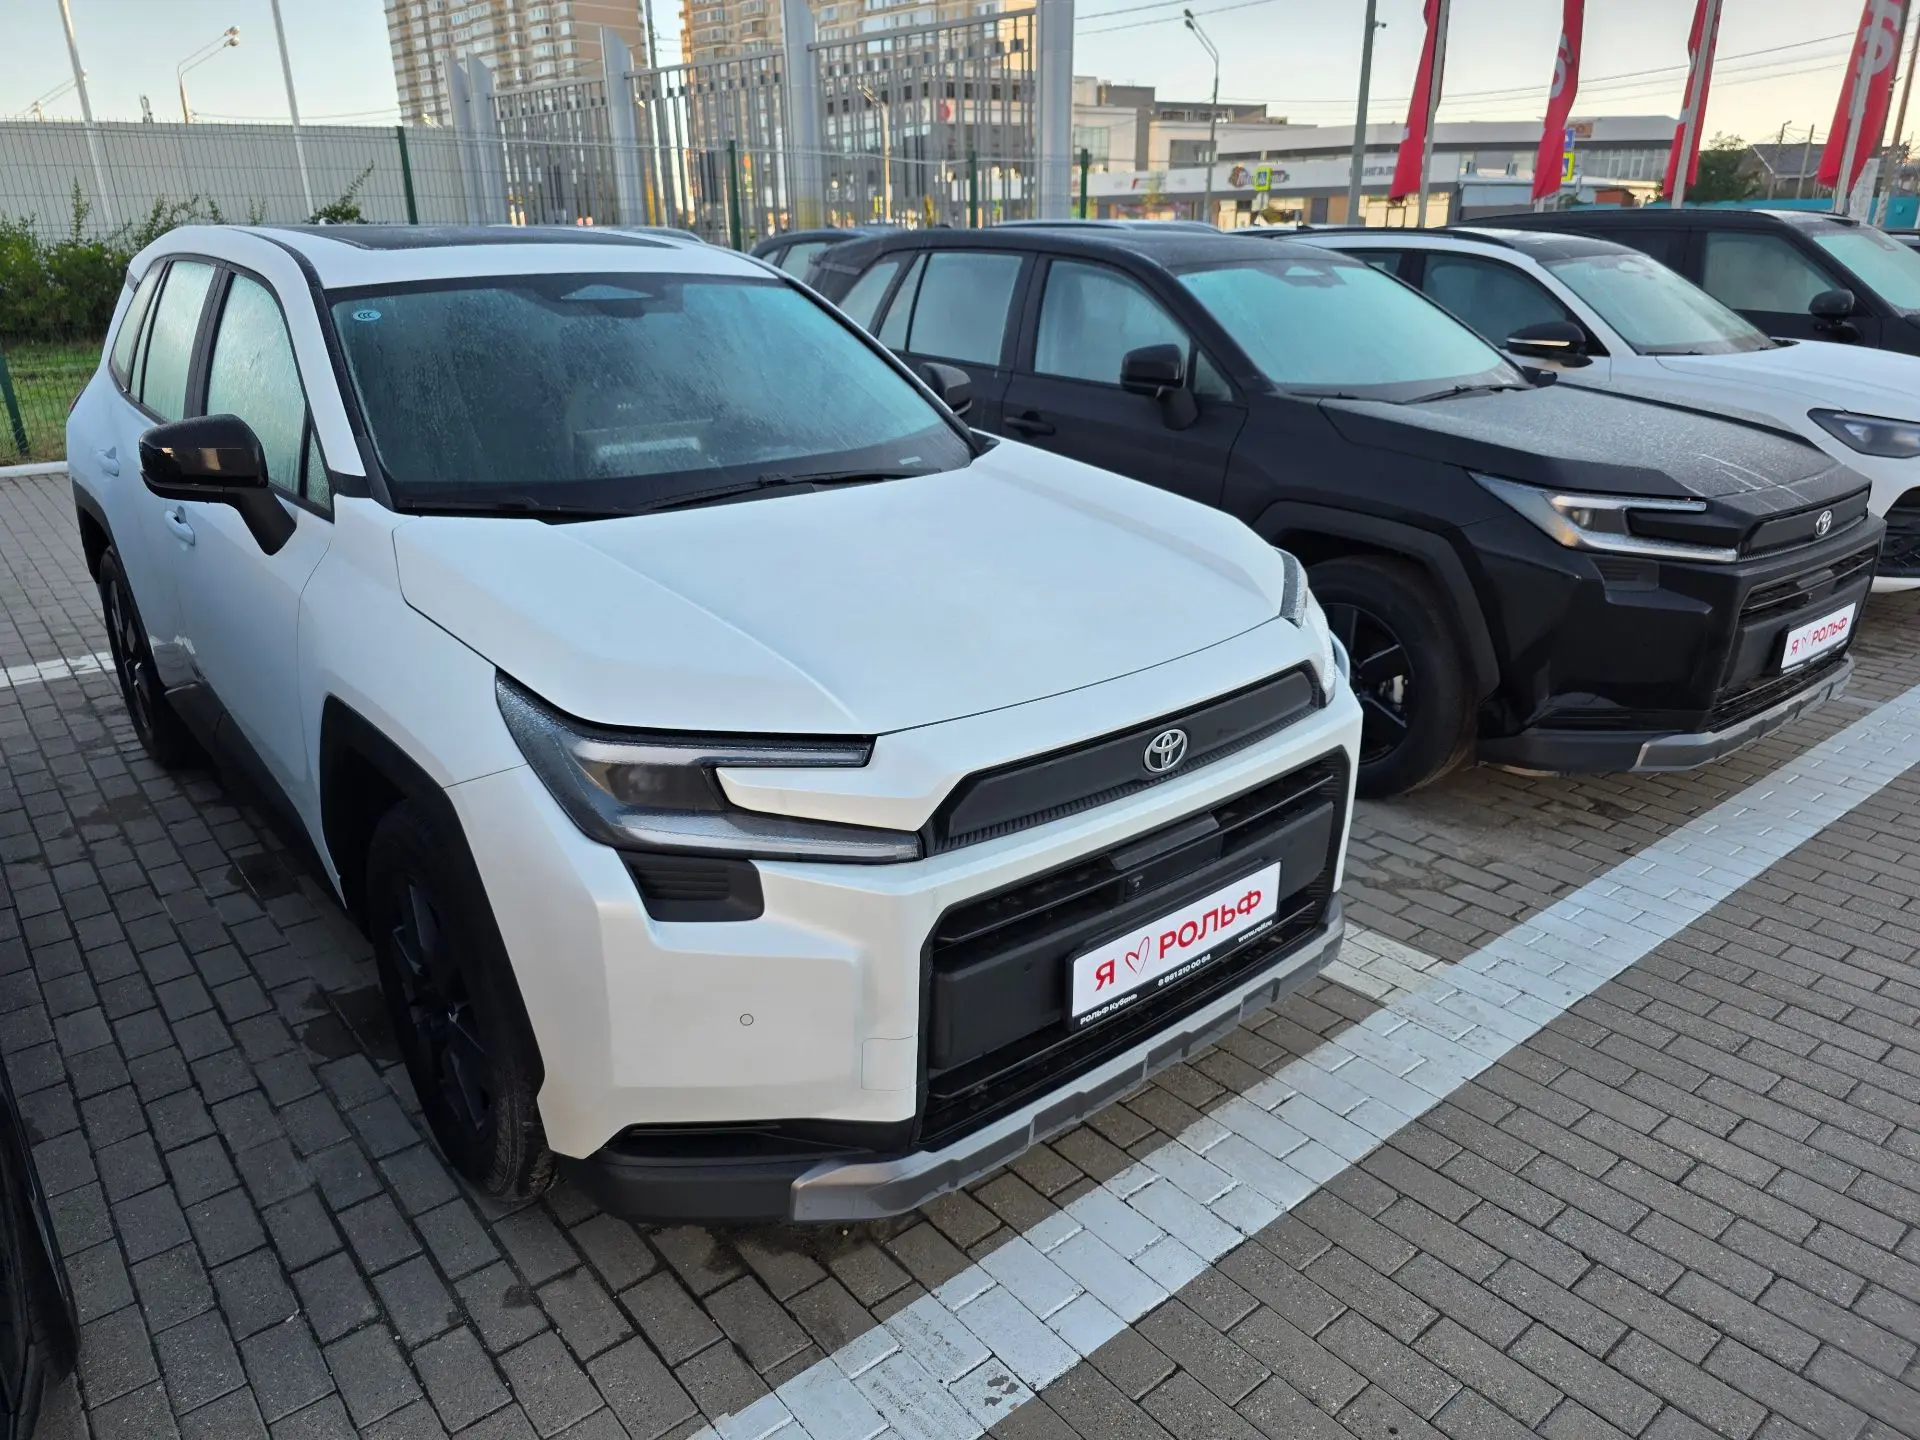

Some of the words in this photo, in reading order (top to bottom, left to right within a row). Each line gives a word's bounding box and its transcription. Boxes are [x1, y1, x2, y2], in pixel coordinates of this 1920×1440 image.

[1790, 639, 1799, 656] Я
[1811, 616, 1848, 646] РОЛЬФ
[1095, 959, 1115, 992] Я
[1159, 889, 1262, 960] РОЛЬФ
[1191, 958, 1201, 969] 00
[1080, 1006, 1110, 1025] РОЛЬФ
[1110, 993, 1138, 1011] Кубань
